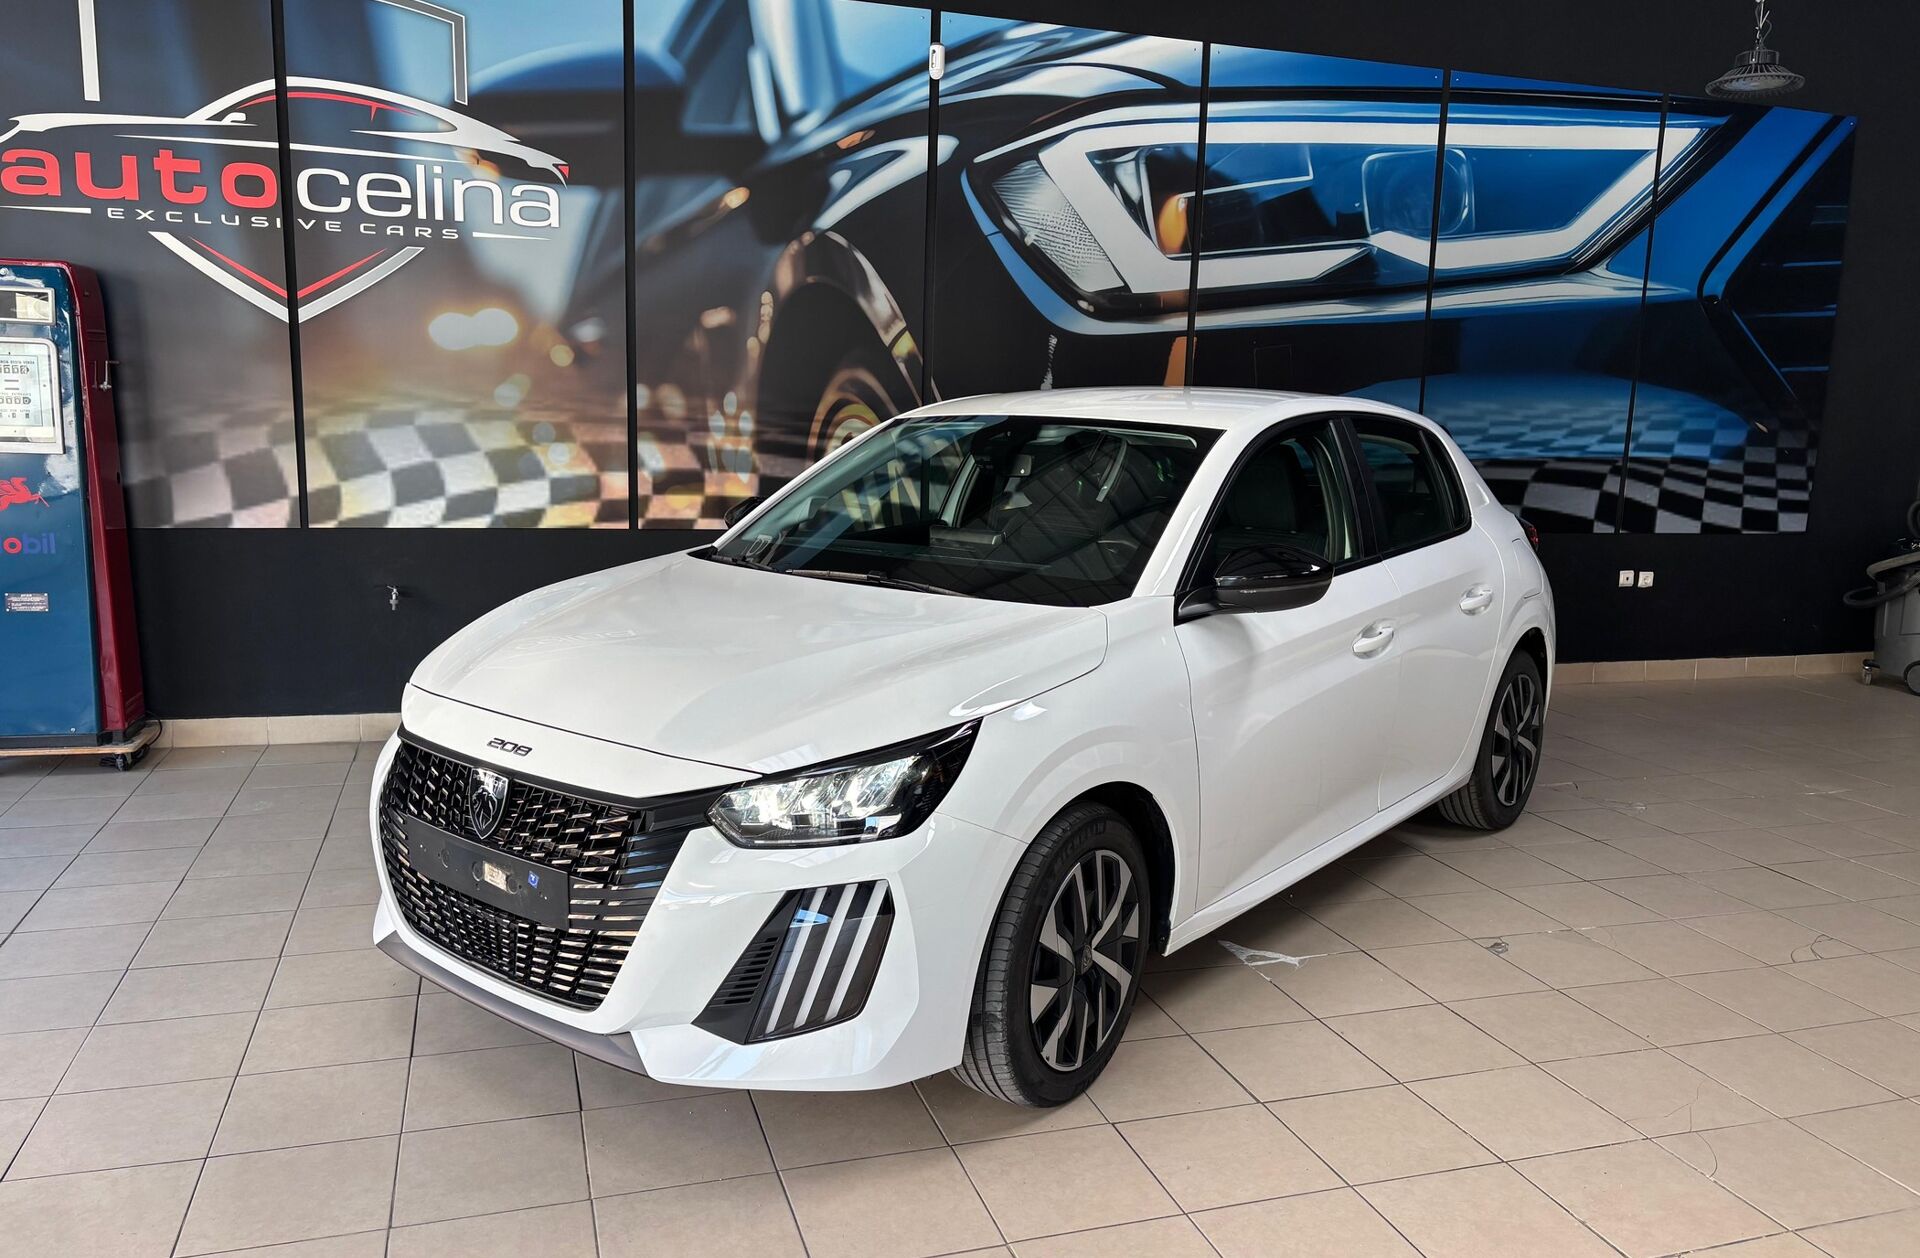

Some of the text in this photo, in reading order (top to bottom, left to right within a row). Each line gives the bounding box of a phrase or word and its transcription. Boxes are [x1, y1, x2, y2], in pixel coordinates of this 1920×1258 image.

[107, 207, 459, 239] EXCLUSIVE CARS
[0, 532, 56, 555] obil
[487, 737, 532, 756] 208
